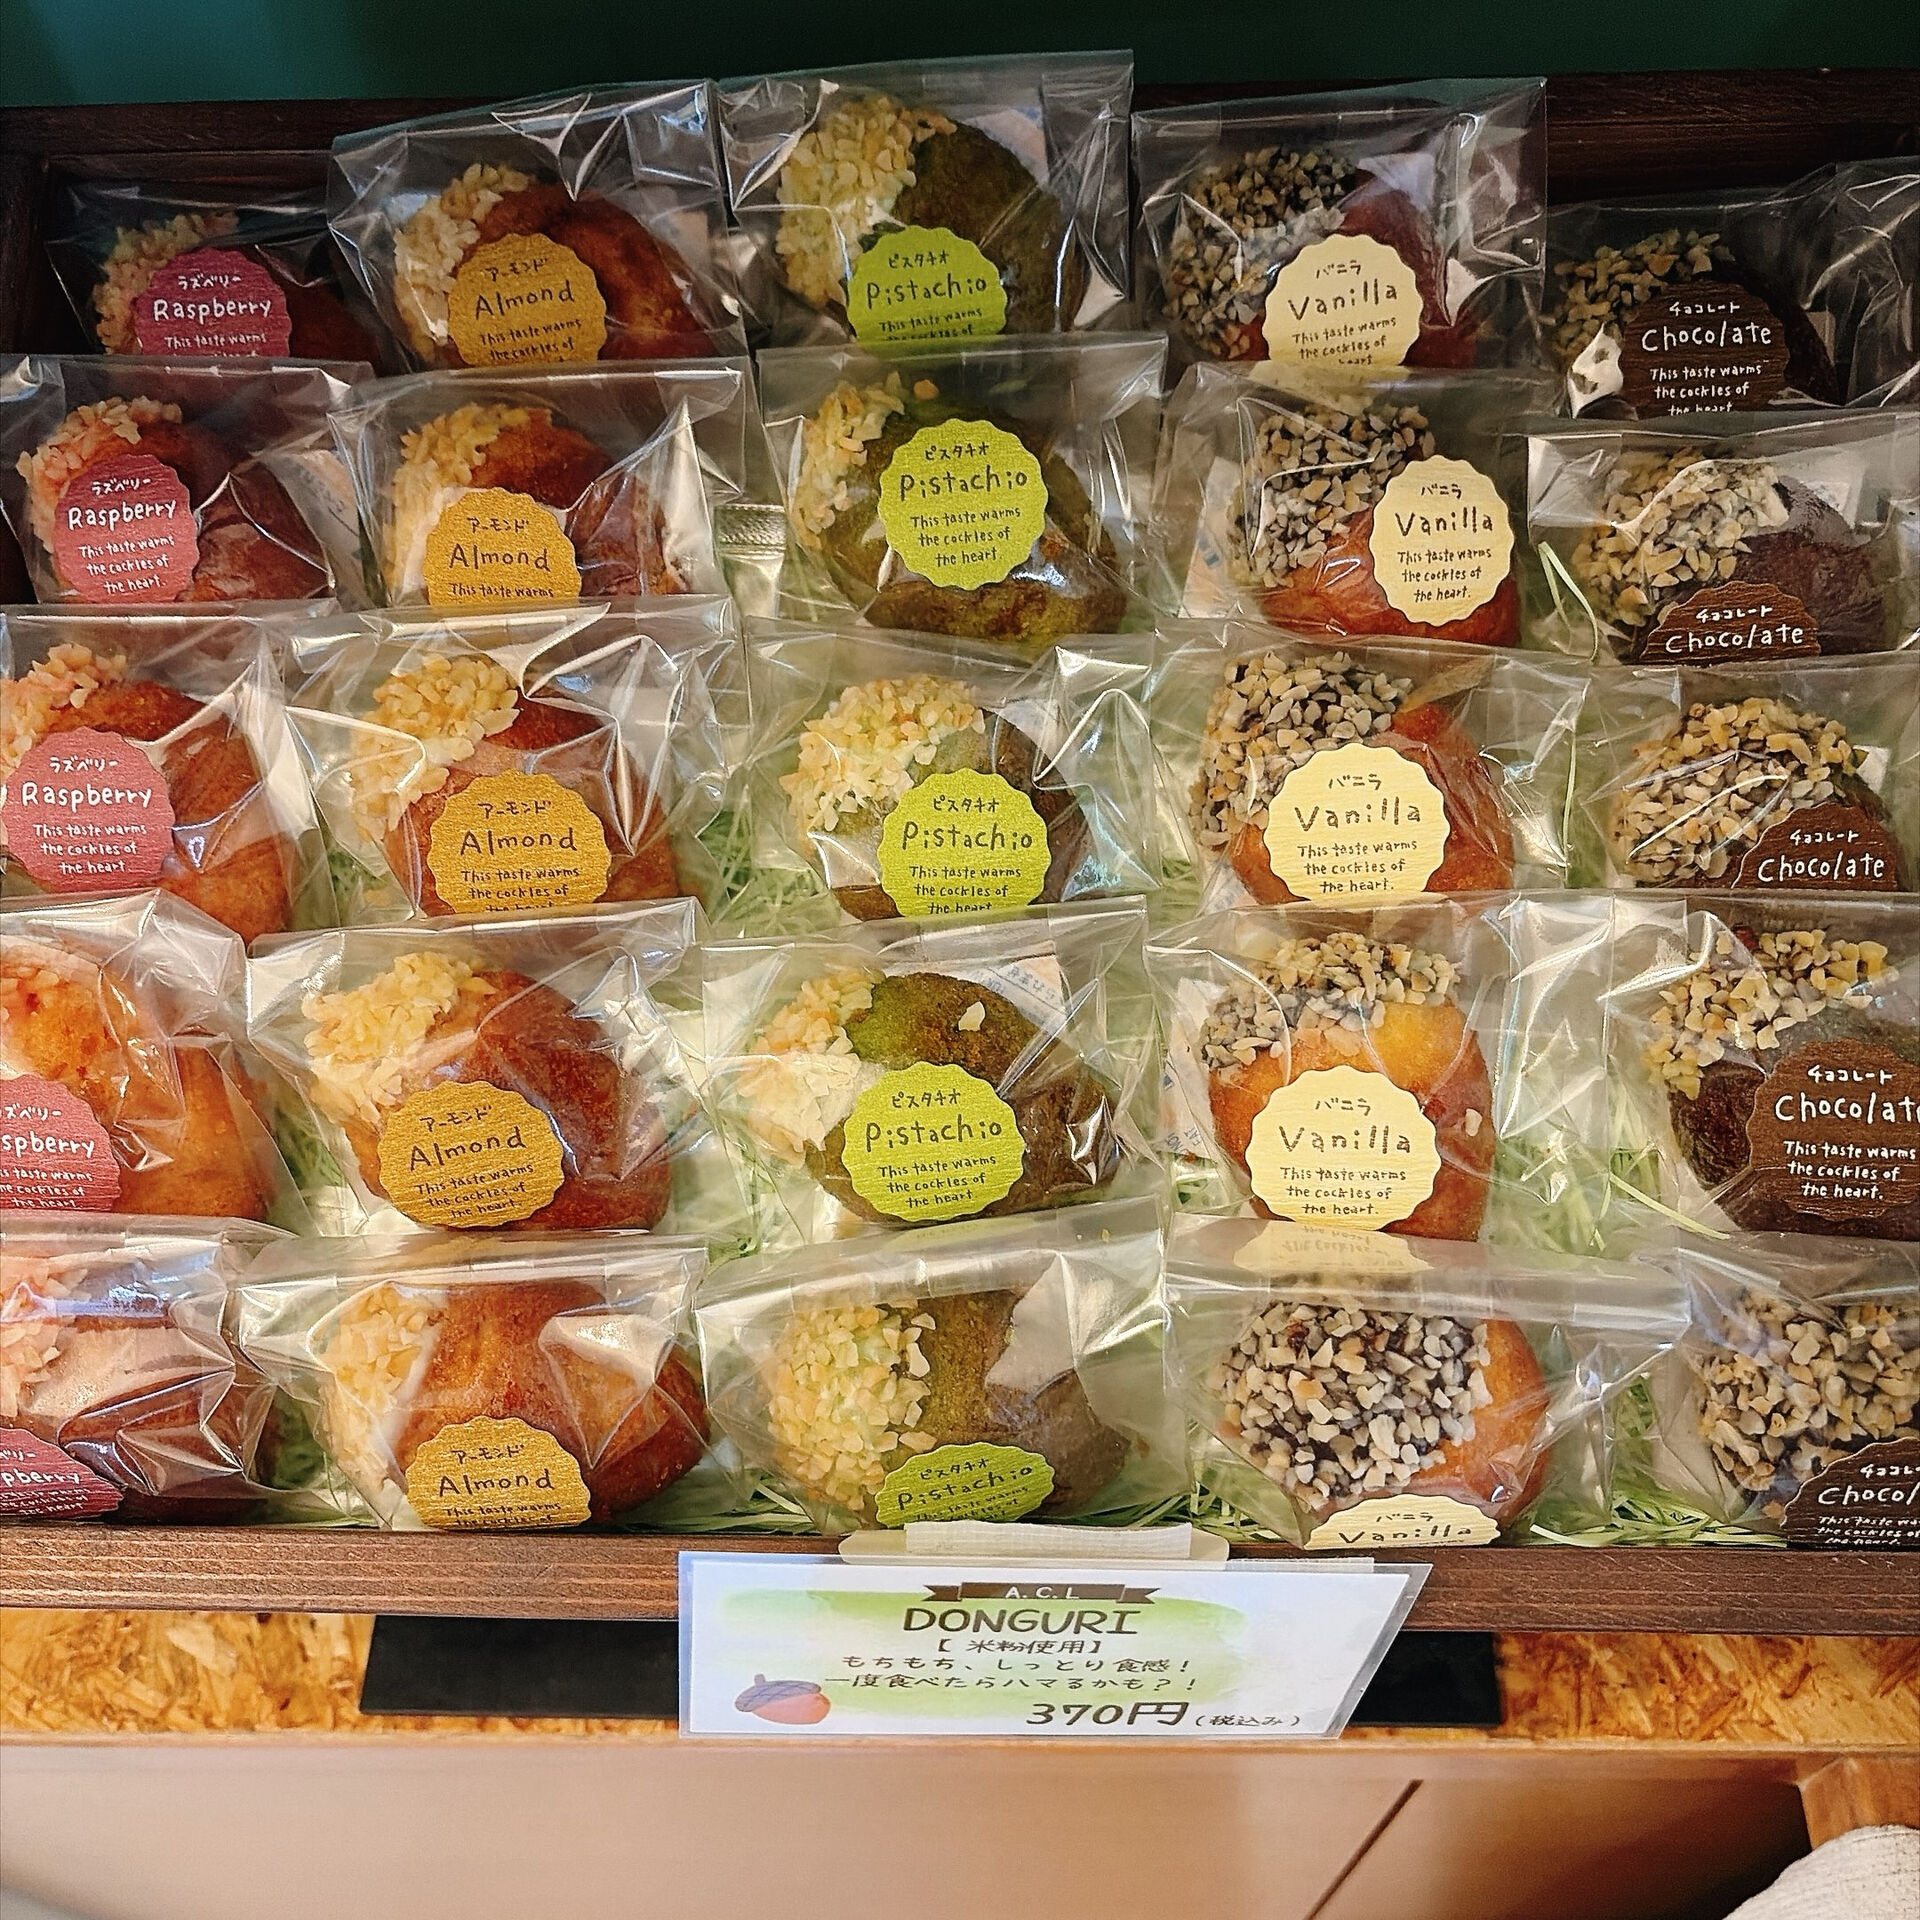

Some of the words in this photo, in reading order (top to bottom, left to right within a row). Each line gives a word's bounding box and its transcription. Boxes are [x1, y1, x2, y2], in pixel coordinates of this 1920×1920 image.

[889, 250, 949, 269] ピスタチオ
[1316, 260, 1361, 279] バニラ
[178, 273, 242, 290] ラズベリー
[867, 273, 987, 309] Pistachio
[475, 280, 575, 320] Almond
[1288, 278, 1398, 320] Vanilla
[154, 297, 272, 324] Raspberry
[1669, 302, 1740, 316] チョコレート
[1292, 333, 1319, 345] This
[1323, 325, 1355, 340] taste
[1358, 317, 1397, 333] warms
[1642, 321, 1771, 351] Chocolate
[1300, 349, 1318, 359] the
[1323, 341, 1370, 357] cockles
[1375, 335, 1387, 347] of
[1650, 368, 1678, 381] This
[1683, 366, 1715, 380] taste
[1720, 365, 1762, 377] warms
[1655, 386, 1675, 399] the
[1680, 385, 1730, 398] cockles
[1736, 382, 1749, 396] of
[925, 442, 989, 460] ピスタチオ
[92, 478, 151, 496] ラズベリー
[900, 465, 1027, 501] Pistachio
[1421, 484, 1462, 499] バニラ
[68, 500, 176, 531] Raspberry
[467, 517, 529, 533] アーモンド
[911, 516, 939, 529] This
[943, 511, 976, 526] taste
[980, 507, 1021, 521] warms
[1395, 506, 1493, 536] Vanilla
[918, 533, 939, 546] the
[944, 529, 993, 544] cockles
[998, 526, 1010, 540] of
[79, 546, 103, 559] This
[106, 541, 135, 555] taste
[138, 536, 174, 550] warms
[1397, 551, 1422, 565] This
[1426, 549, 1454, 564] taste
[1457, 549, 1491, 559] warms
[86, 563, 106, 576] the
[110, 559, 153, 574] cockles
[156, 554, 169, 567] of
[449, 543, 551, 572] Almond
[936, 554, 956, 567] the
[1402, 571, 1420, 582] the
[1424, 569, 1466, 581] cockles
[1470, 566, 1482, 579] of
[104, 581, 124, 594] the
[449, 583, 476, 596] This
[480, 584, 511, 597] taste
[515, 588, 554, 597] warms
[1414, 590, 1432, 603] the
[1436, 586, 1471, 600] heart.
[1696, 605, 1773, 623] チョコレート
[1666, 624, 1803, 653] Chocolate
[50, 755, 119, 773] ラズベリー
[1328, 774, 1382, 790] バニラ
[21, 781, 152, 813] Raspberry
[934, 795, 999, 813] ピスタチオ
[478, 801, 551, 819] アーモンド
[1294, 796, 1421, 832] Vanilla
[33, 824, 62, 838] This
[66, 824, 101, 837] taste
[104, 824, 147, 836] warms
[902, 821, 1033, 850] Pistachio
[1790, 829, 1859, 846] チョコレート
[40, 843, 63, 855] the
[68, 842, 120, 856] cockles
[124, 842, 137, 854] of
[460, 827, 577, 855] Almond
[1297, 845, 1328, 859] This
[1332, 842, 1368, 857] taste
[1373, 841, 1418, 853] warms
[59, 861, 82, 875] the
[461, 870, 491, 882] This
[496, 869, 531, 882] taste
[536, 868, 580, 879] warms
[909, 866, 938, 879] This
[942, 867, 976, 880] taste
[980, 868, 1021, 878] warms
[1304, 862, 1327, 875] the
[1332, 861, 1386, 874] cockles
[1391, 858, 1406, 872] of
[1758, 850, 1885, 882] Chocolate
[469, 888, 491, 899] the
[497, 887, 550, 898] cockles
[555, 884, 569, 896] of
[915, 884, 935, 896] the
[940, 885, 990, 896] cockles
[995, 885, 1009, 897] of
[1320, 880, 1344, 894] the
[1349, 878, 1394, 892] heart.
[1808, 1064, 1893, 1085] チョコレート
[892, 1088, 961, 1109] ピスタチオ
[1315, 1098, 1371, 1116] バニラ
[0, 1102, 62, 1121] ズベリー
[420, 1105, 492, 1132] アーモンド
[866, 1113, 1002, 1152] Pistachio
[1279, 1125, 1411, 1155] Vanilla
[0, 1131, 94, 1159] spberry
[410, 1126, 527, 1171] Almond
[1783, 1140, 1816, 1157] This
[1822, 1142, 1862, 1158] taste
[1867, 1147, 1916, 1160] warms
[877, 1166, 908, 1178] This
[912, 1160, 948, 1175] taste
[952, 1156, 997, 1169] warms
[1280, 1167, 1312, 1181] This
[1316, 1167, 1354, 1181] taste
[1359, 1170, 1406, 1181] warms
[1787, 1160, 1813, 1175] the
[1817, 1165, 1878, 1180] cockles
[1883, 1167, 1900, 1182] of
[414, 1183, 446, 1196] This
[450, 1174, 485, 1191] taste
[489, 1164, 534, 1181] warms
[886, 1182, 910, 1193] the
[914, 1178, 967, 1191] cockles
[972, 1173, 986, 1184] of
[454, 1189, 507, 1204] cockles
[512, 1182, 526, 1193] of
[1287, 1185, 1310, 1197] the
[1315, 1186, 1371, 1199] cockles
[1377, 1187, 1393, 1199] of
[1801, 1182, 1828, 1196] the
[1834, 1184, 1883, 1200] heart.
[906, 1197, 929, 1208] the
[1302, 1204, 1326, 1215] the
[1333, 1204, 1379, 1215] heart.
[451, 1444, 525, 1465] アーモンド
[1, 1468, 80, 1487] pberry
[920, 1458, 989, 1480] ピスタチオ
[1860, 1464, 1920, 1478] チョコレ
[439, 1468, 555, 1497] Almond
[897, 1466, 1032, 1511] Pistachio
[1818, 1485, 1920, 1505] Chocol
[1376, 1512, 1434, 1523] バニラ
[1339, 1524, 1472, 1543] Vanilla
[902, 1608, 1142, 1635] DONGURI
[1026, 1701, 1190, 1727] 370円
